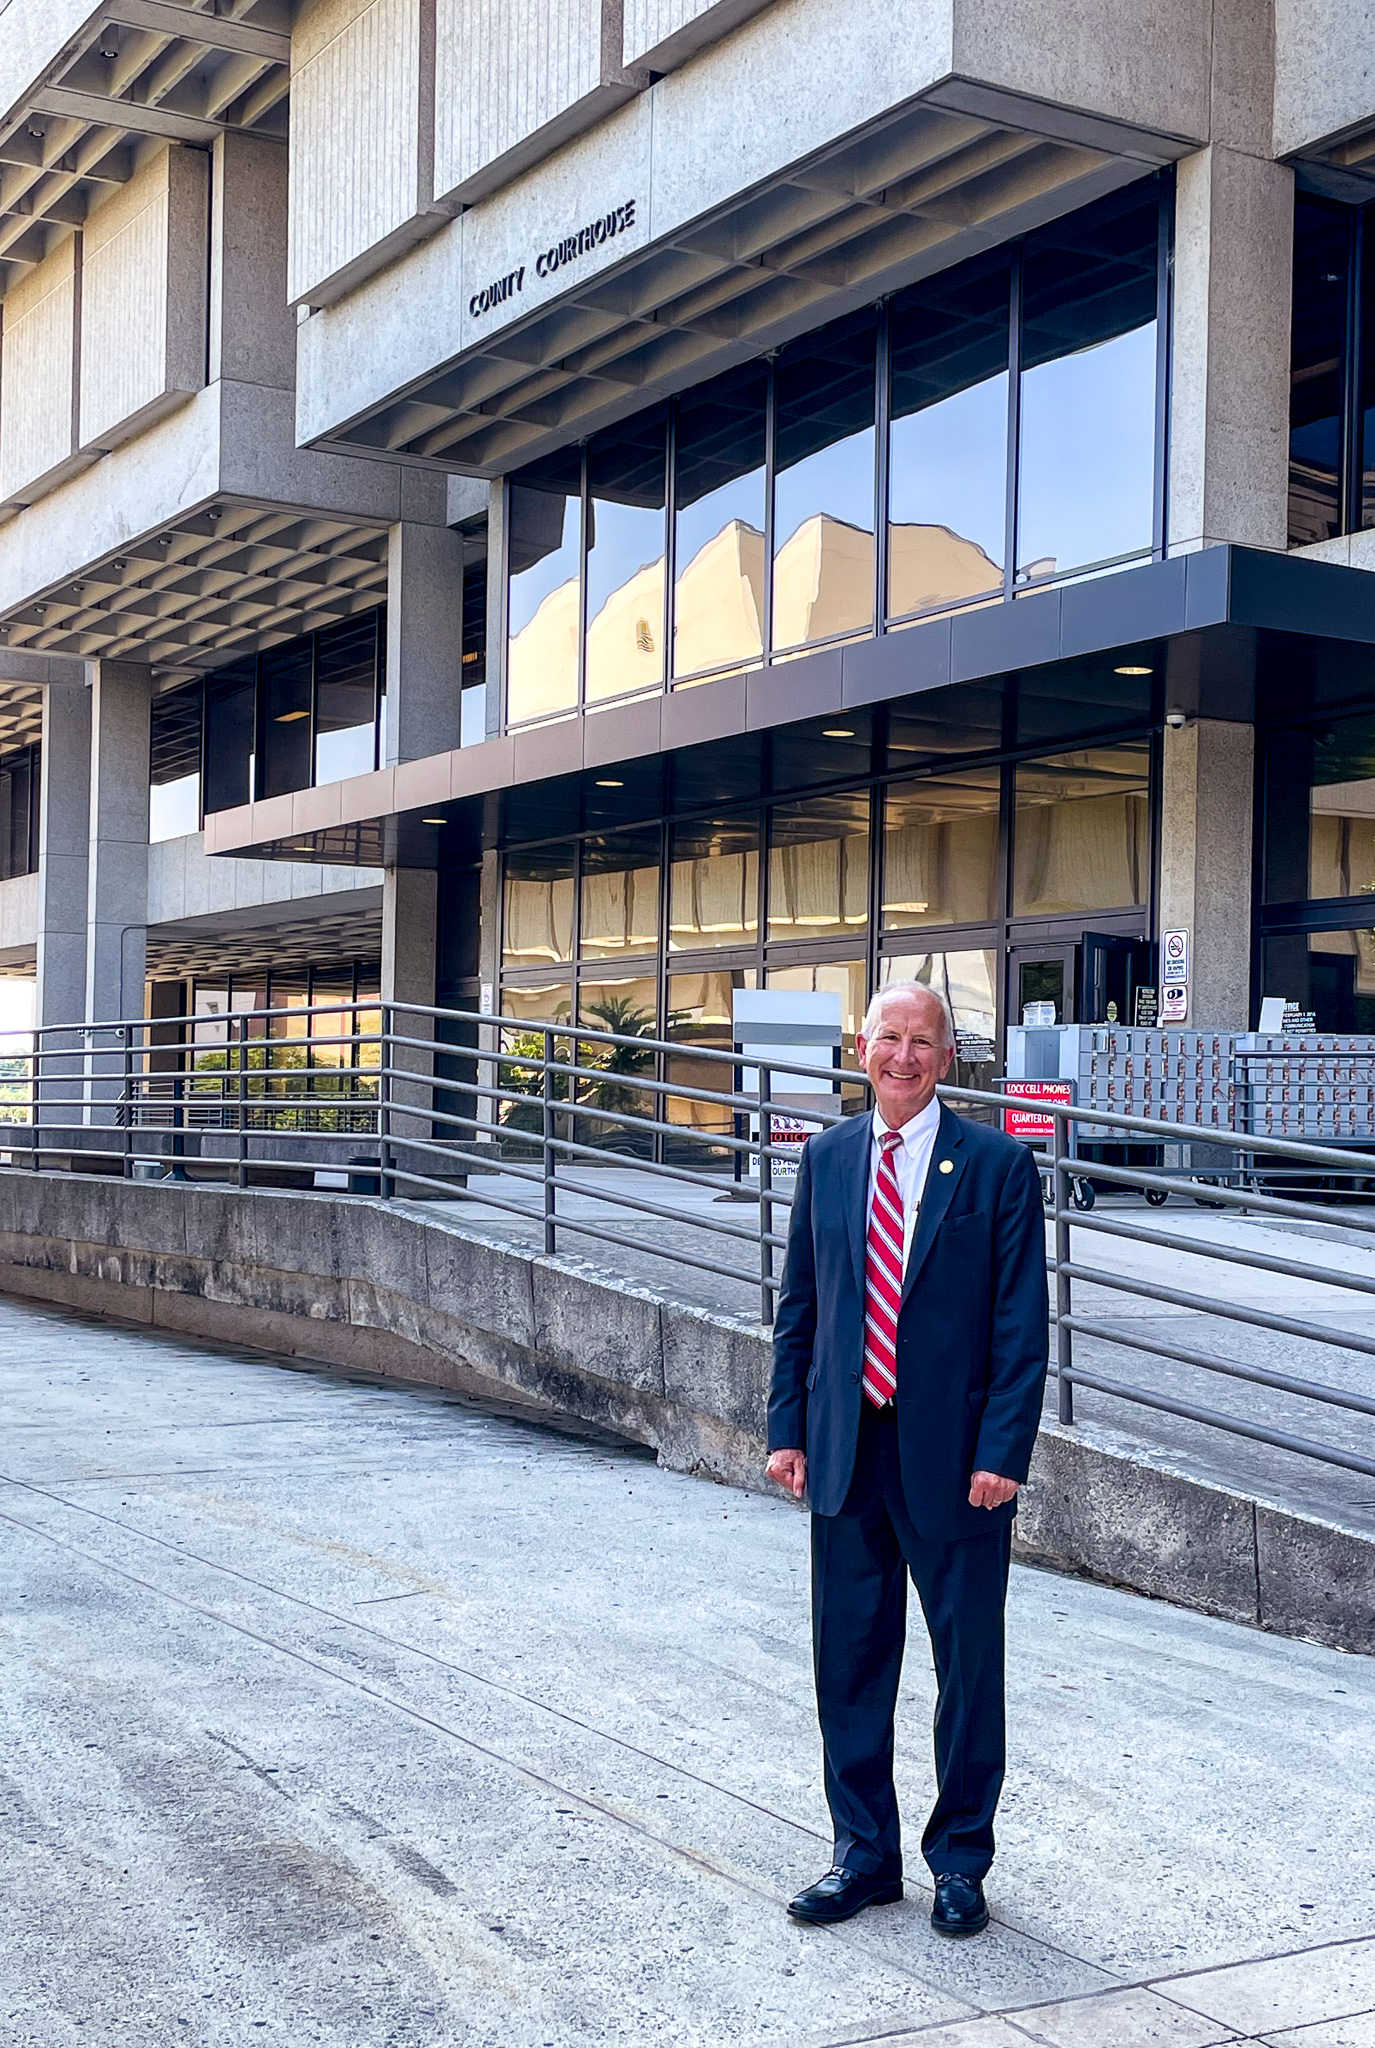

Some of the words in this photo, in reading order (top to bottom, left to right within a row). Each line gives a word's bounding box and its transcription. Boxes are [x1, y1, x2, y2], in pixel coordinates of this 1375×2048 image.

[470, 266, 525, 317] COUNTY
[536, 199, 636, 278] COURTHOUSE
[1007, 1084, 1024, 1094] LOCK
[1025, 1084, 1041, 1094] CELL
[1043, 1084, 1070, 1094] PHONES
[1012, 1113, 1042, 1123] QUARTER
[1043, 1114, 1054, 1123] ON
